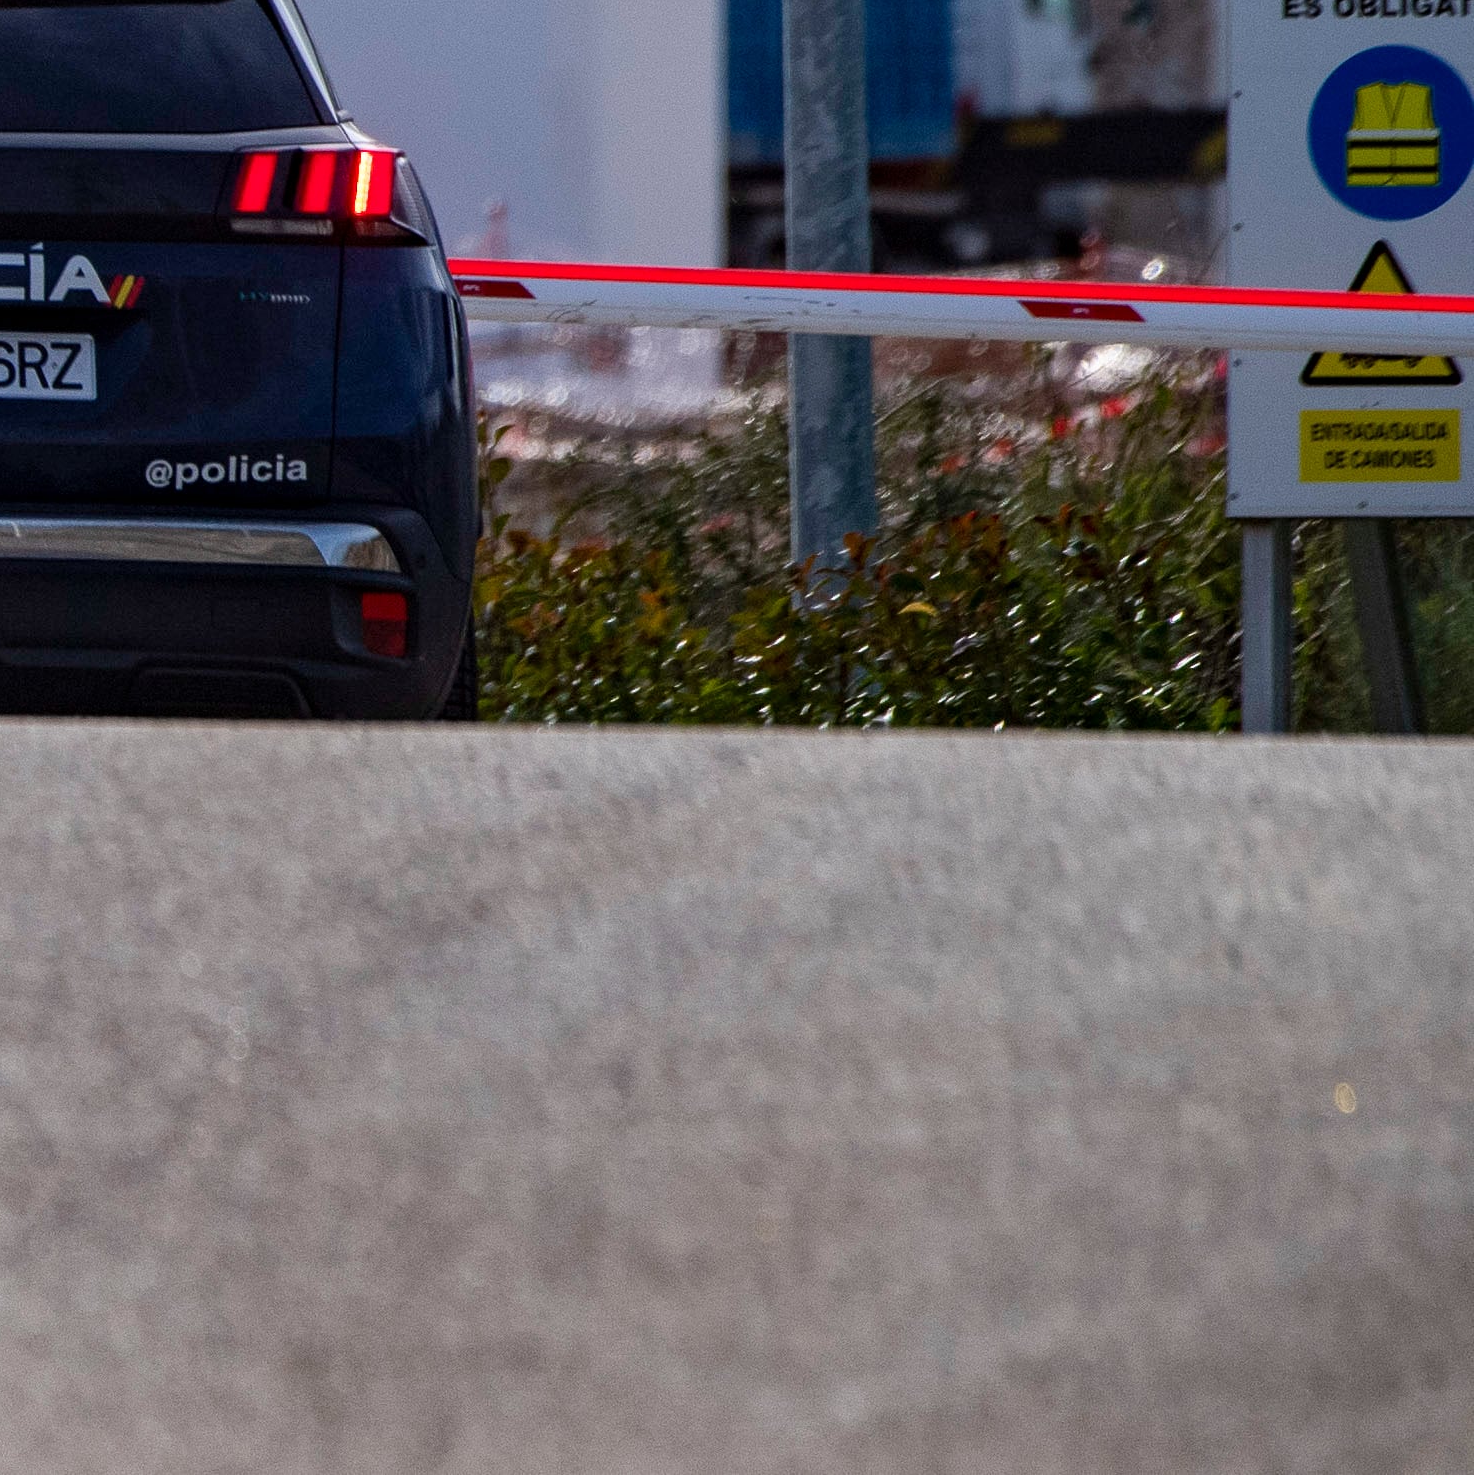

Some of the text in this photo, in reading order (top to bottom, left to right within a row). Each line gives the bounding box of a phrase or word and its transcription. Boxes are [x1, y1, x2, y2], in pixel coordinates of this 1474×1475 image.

[145, 453, 308, 491] @policia
[1324, 449, 1437, 470] DE CAMIONES
